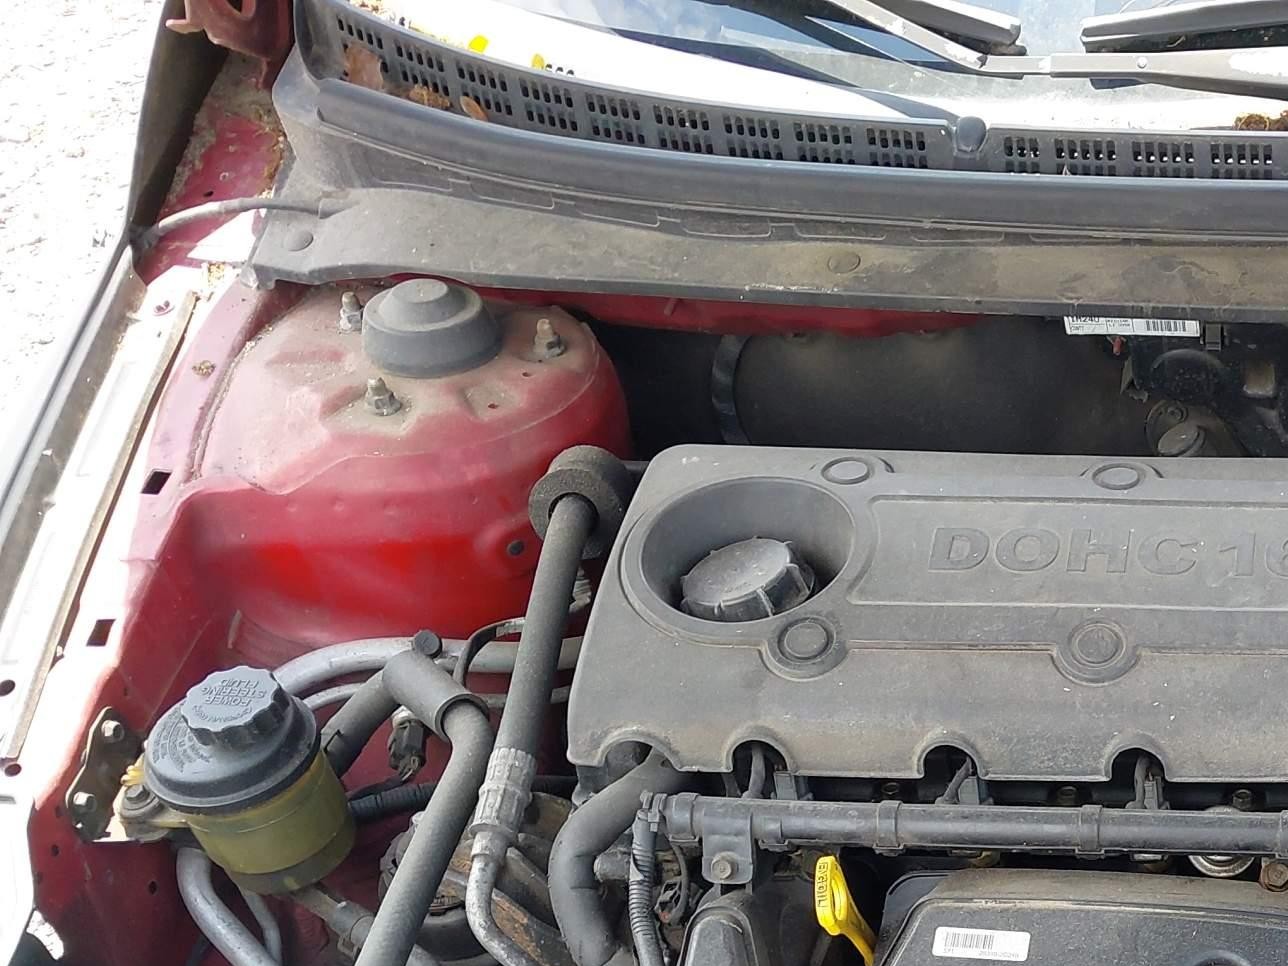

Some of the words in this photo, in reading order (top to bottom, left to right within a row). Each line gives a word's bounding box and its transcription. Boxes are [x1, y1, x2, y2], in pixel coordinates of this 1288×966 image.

[928, 527, 1199, 574] DOHC
[220, 678, 259, 688] FLUID
[201, 686, 267, 699] STEERING
[204, 697, 252, 707] POWER
